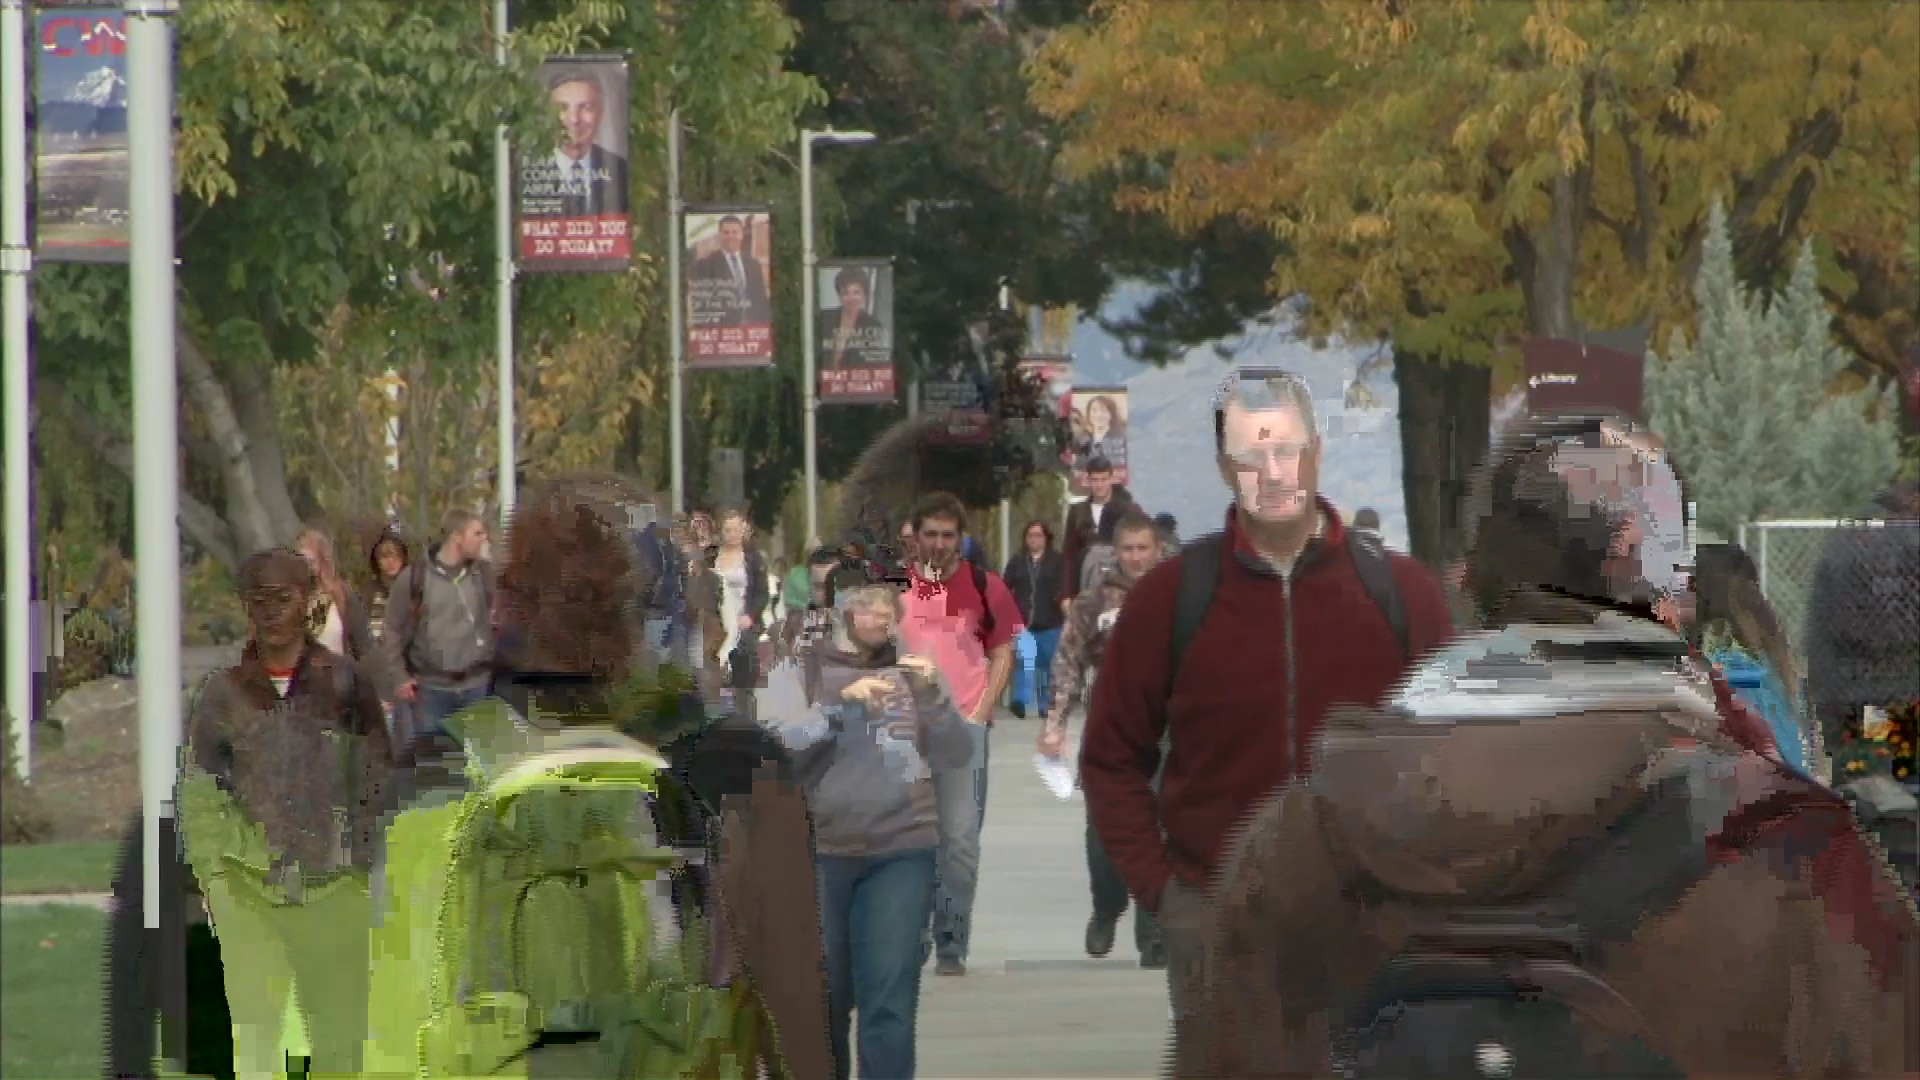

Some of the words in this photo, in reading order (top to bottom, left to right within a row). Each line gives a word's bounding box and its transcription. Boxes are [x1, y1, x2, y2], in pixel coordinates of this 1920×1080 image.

[522, 221, 559, 236] WHAT
[566, 221, 594, 236] DID
[599, 221, 627, 236] YOU
[535, 240, 554, 254] DO
[558, 239, 614, 254] TODAY?
[690, 329, 719, 341] WHAT
[722, 328, 744, 340] DID
[748, 328, 769, 340] YOU
[699, 343, 714, 354] DO
[718, 342, 760, 354] TODAY?
[822, 370, 848, 381] WHAT
[851, 370, 870, 381] DID
[873, 369, 892, 381] YOU
[1541, 372, 1577, 385] Library
